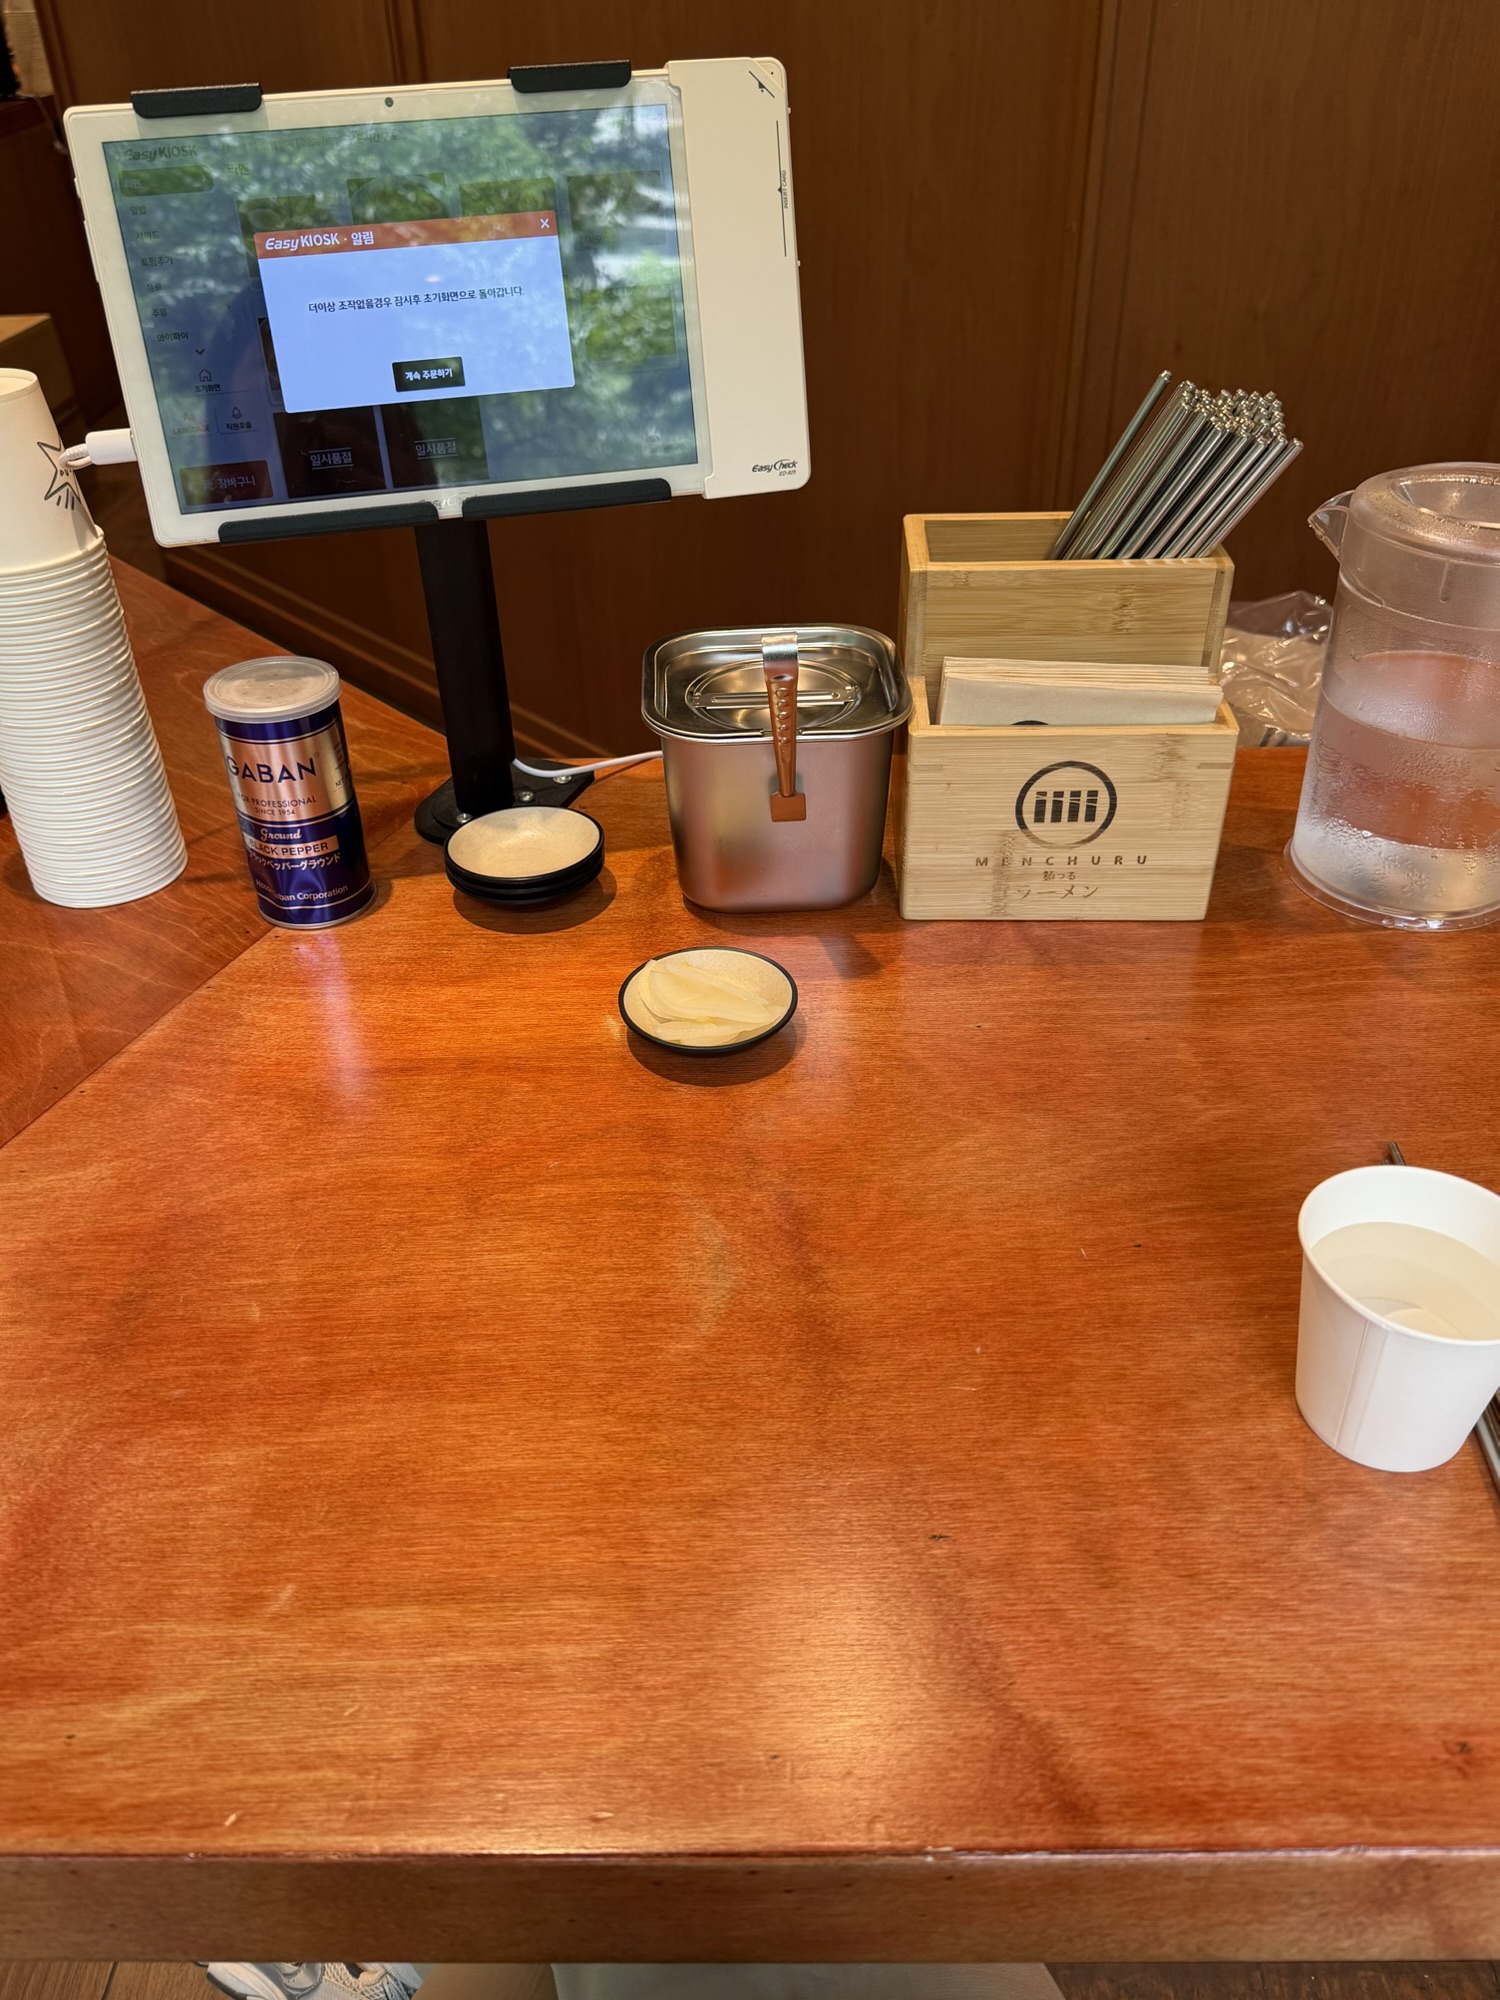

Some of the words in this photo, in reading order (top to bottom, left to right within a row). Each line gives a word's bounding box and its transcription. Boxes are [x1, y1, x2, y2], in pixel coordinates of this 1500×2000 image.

[350, 231, 374, 246] 알림
[308, 301, 336, 313] 더이상
[338, 296, 393, 311] 조작없을경우
[394, 294, 421, 307] 잠시후
[423, 289, 477, 304] 초기화면으로
[478, 285, 526, 300] 돌아갑니다.
[156, 331, 189, 342] 와이파이
[405, 371, 422, 381] 계속
[422, 368, 454, 380] 주문하기
[415, 441, 457, 457] 일시품절
[310, 451, 353, 467] 일시품절
[218, 476, 256, 490] 장바구니
[226, 755, 316, 784] GABAN
[251, 796, 318, 809] PROFESSIONAL
[254, 808, 276, 816] SINCE
[260, 828, 302, 842] Ground
[249, 838, 279, 856] BLACK
[281, 842, 329, 856] PEPPER
[975, 855, 1148, 867] MENCHURU
[297, 884, 349, 901] Corporation
